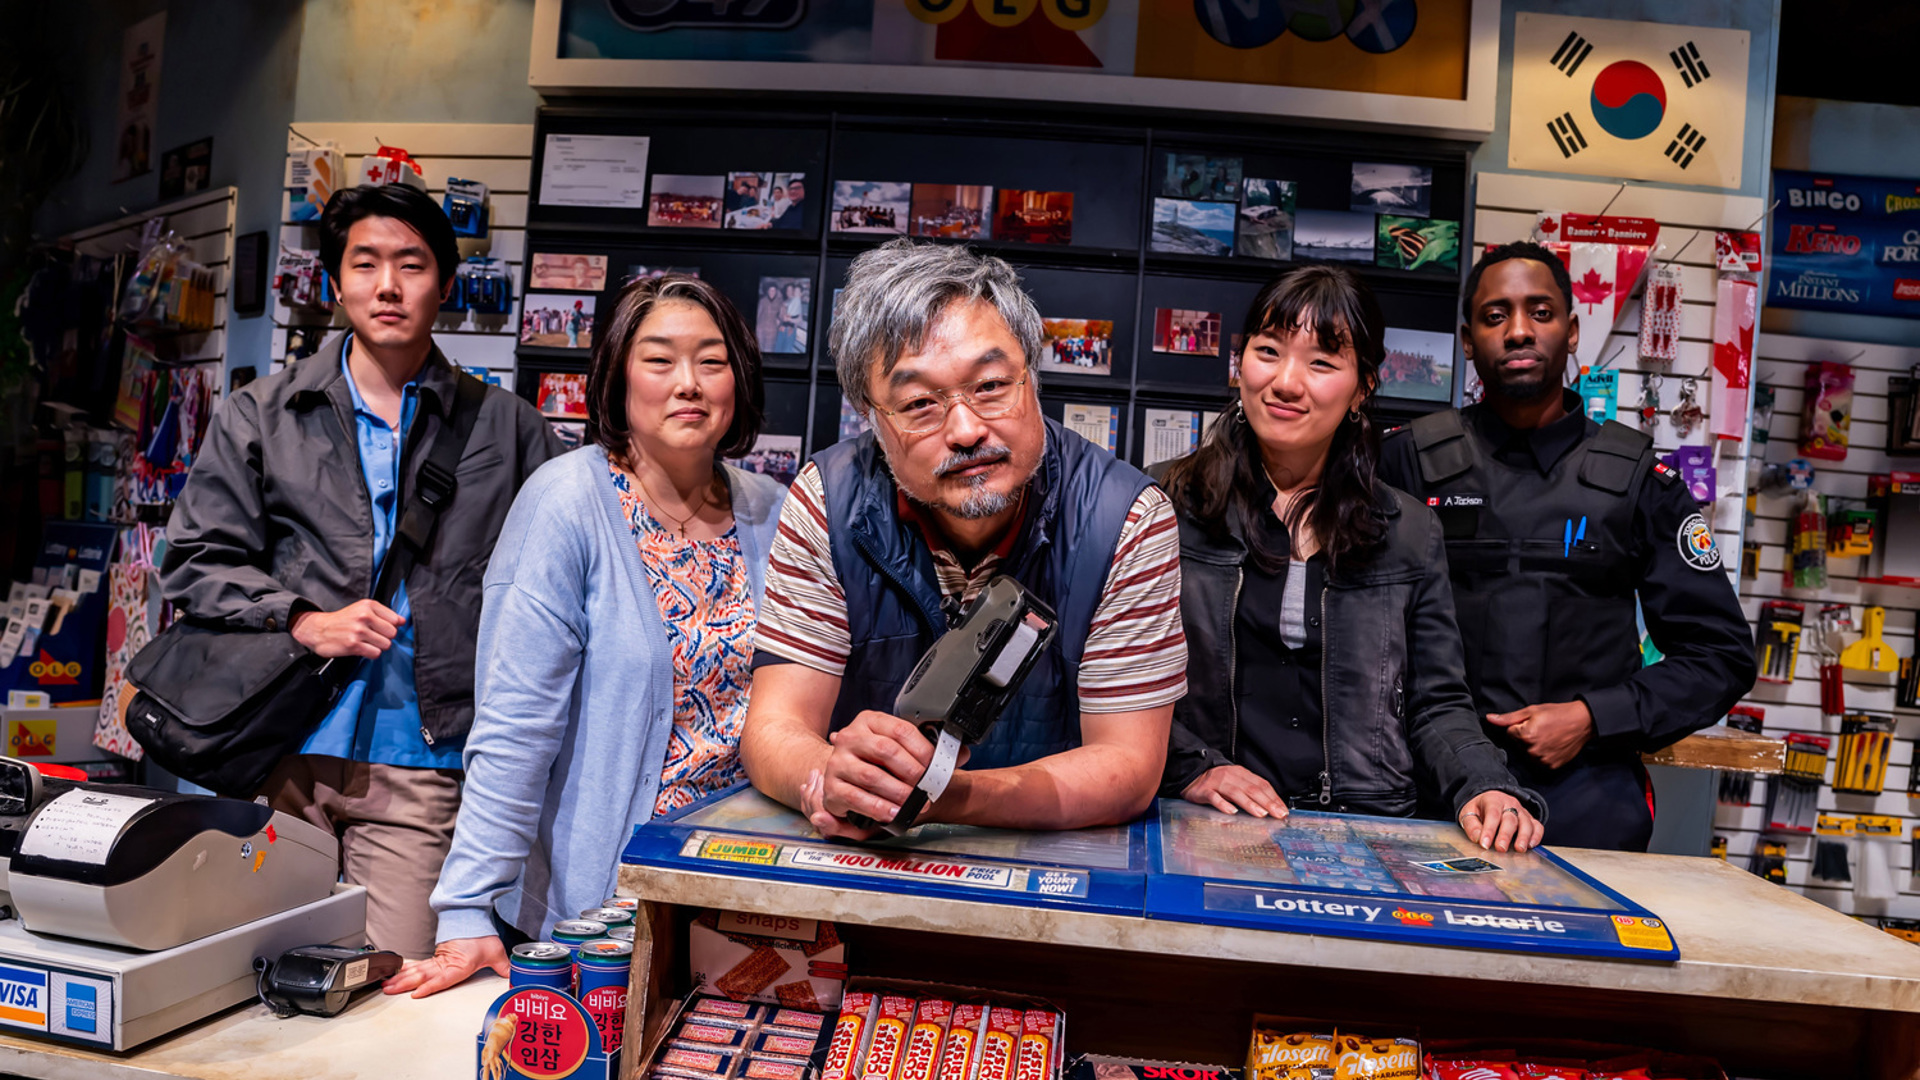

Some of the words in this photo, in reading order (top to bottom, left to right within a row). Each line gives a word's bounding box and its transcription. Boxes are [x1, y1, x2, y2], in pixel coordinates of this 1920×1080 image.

[1788, 188, 1861, 212] BINGO
[1567, 226, 1599, 237] Banner
[1607, 227, 1648, 240] Bannière
[1785, 224, 1861, 255] KENO
[1882, 246, 1919, 262] FOR
[1777, 280, 1860, 303] MILLIONS
[1798, 274, 1839, 287] INSTANT
[1444, 496, 1454, 507] A
[1454, 495, 1483, 506] Jackson
[32, 664, 78, 676] OLG
[11, 734, 52, 746] OLG
[711, 844, 769, 857] JUMBO
[833, 853, 875, 868] $100
[875, 858, 967, 878] MILLION
[969, 866, 1003, 875] PRIZE
[966, 872, 995, 881] POOL
[1038, 875, 1078, 885] YOURS
[1039, 884, 1074, 894] NOW!
[736, 911, 800, 932] snaps
[1255, 894, 1382, 922] Lottery
[1392, 911, 1434, 922] OLG
[1444, 909, 1566, 933] Loterie
[695, 971, 707, 981] 24
[0, 982, 38, 1009] VISA
[66, 997, 95, 1010] AMERICAN
[530, 993, 549, 1001] bibiyo
[514, 998, 567, 1021] 비비요
[520, 1021, 562, 1046] 강한
[824, 1021, 847, 1071] COFFEE
[832, 1029, 853, 1070] CRISP
[866, 1023, 889, 1074] COFFEE
[877, 1033, 897, 1075] CRISP
[903, 1029, 926, 1080] COFFEE
[521, 1047, 560, 1071] 인삼
[914, 1039, 933, 1080] CRISP
[980, 1037, 998, 1080] OFFEE
[991, 1048, 1007, 1080] RISP
[1018, 1040, 1033, 1080] OFFEE
[1028, 1050, 1043, 1080] RISP
[1339, 1050, 1417, 1076] Glosette
[1143, 1066, 1220, 1080] SKOR
